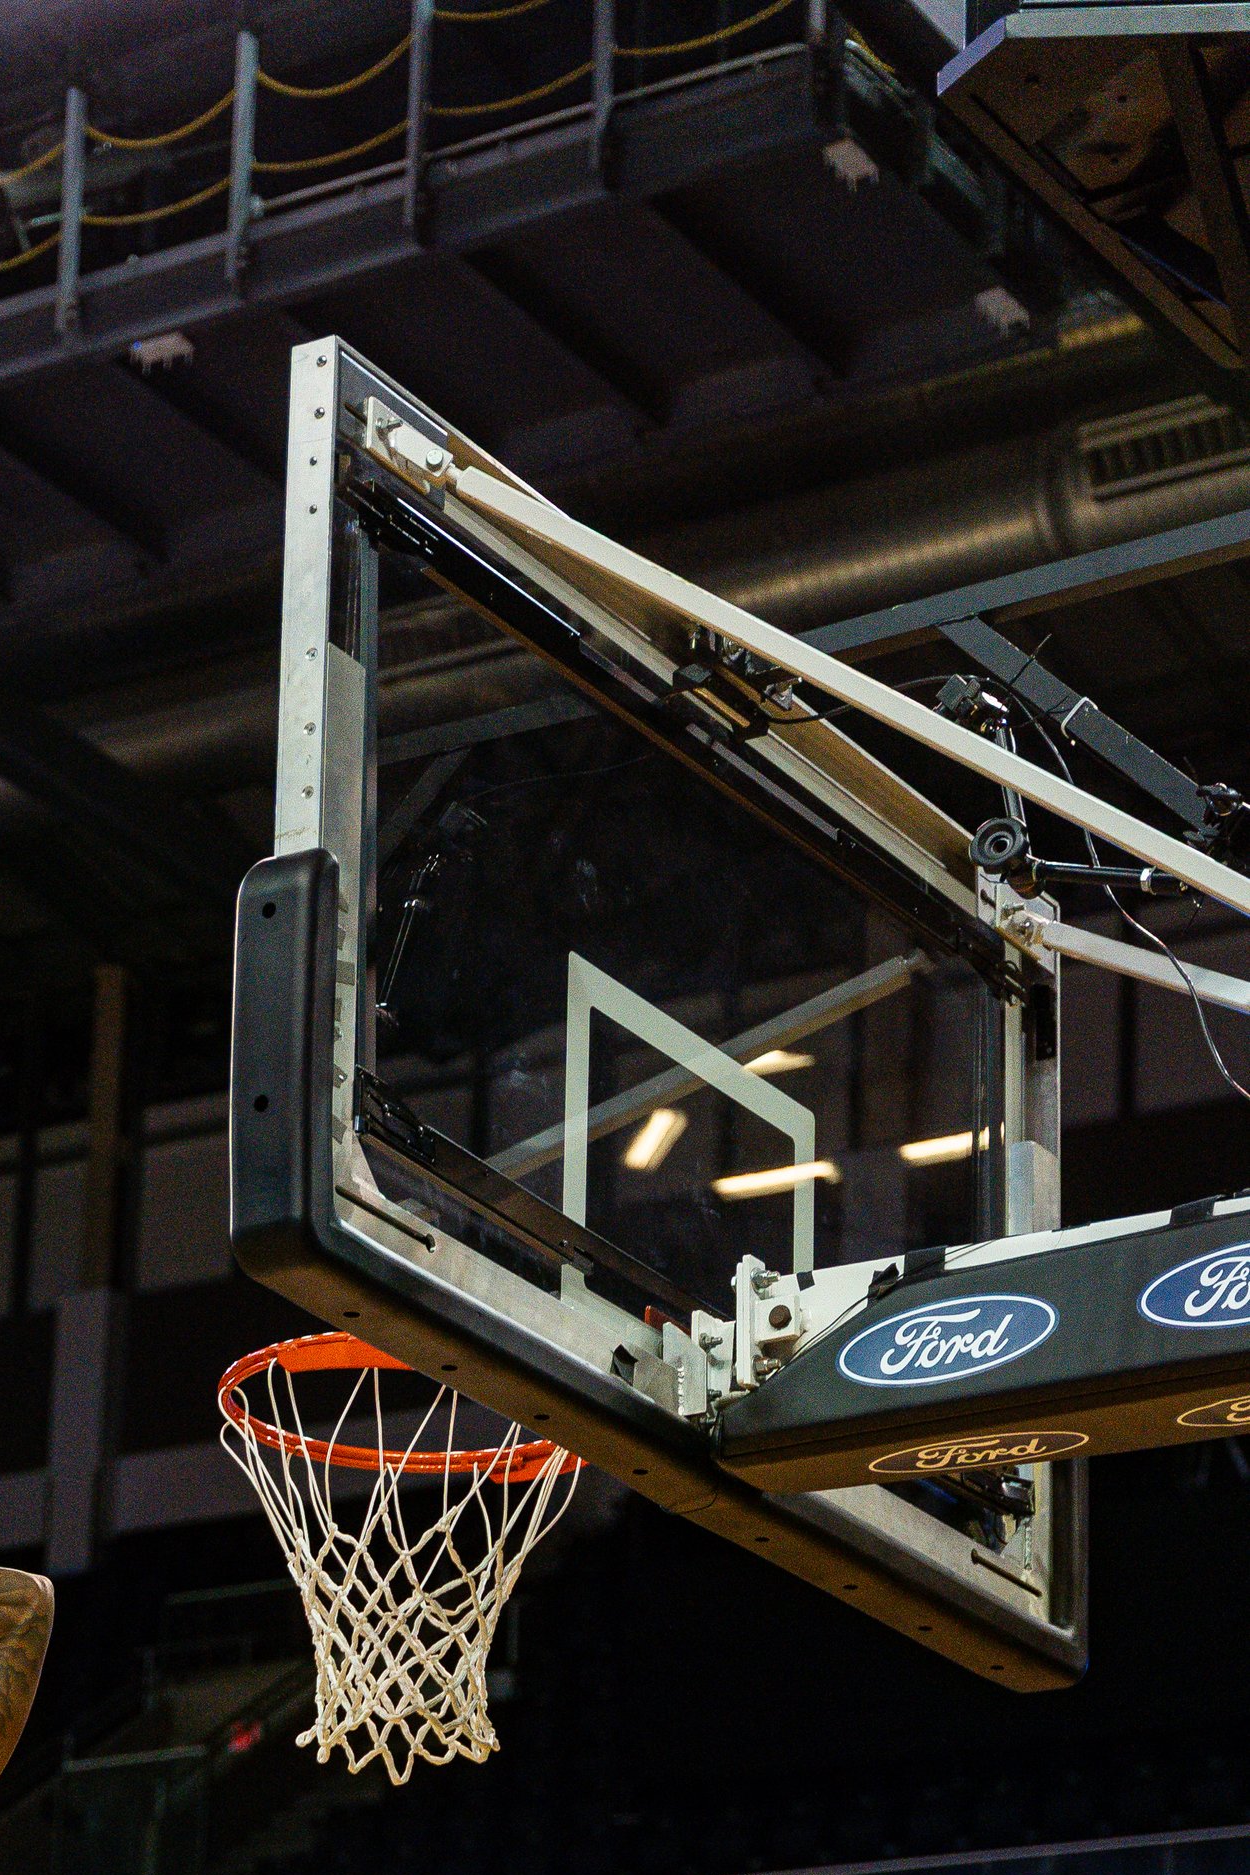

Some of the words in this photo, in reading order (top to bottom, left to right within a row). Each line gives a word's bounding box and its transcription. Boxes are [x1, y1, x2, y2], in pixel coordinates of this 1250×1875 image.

[1184, 1256, 1250, 1317] Fo
[880, 1307, 1014, 1376] Ford
[916, 1438, 1047, 1470] Ford
